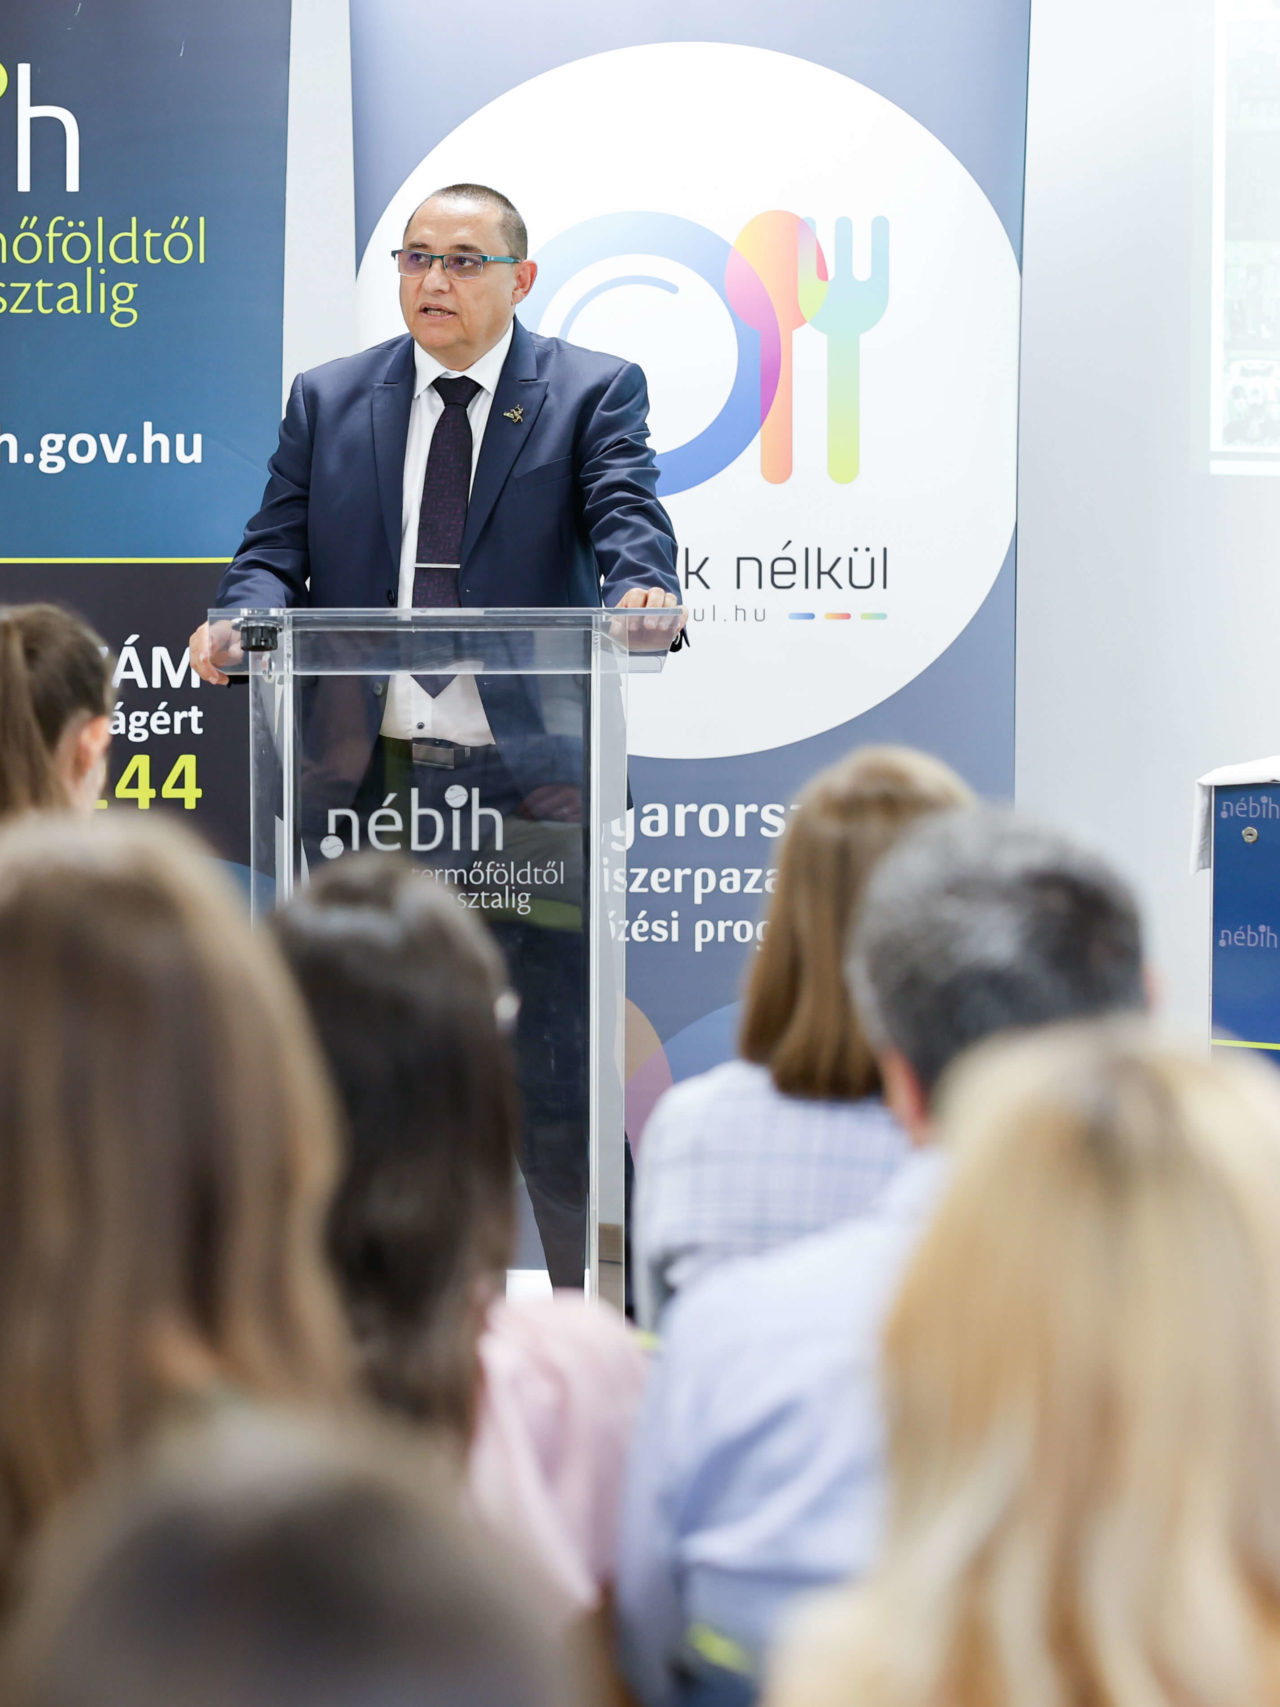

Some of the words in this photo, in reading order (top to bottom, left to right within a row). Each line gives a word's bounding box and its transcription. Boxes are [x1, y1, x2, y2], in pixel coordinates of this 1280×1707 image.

[684, 547, 711, 590] k
[736, 540, 888, 590] nélkül
[693, 604, 766, 623] ul.hu
[108, 701, 204, 743] ágért
[94, 754, 203, 810] 44
[320, 784, 504, 859] nébih
[1220, 796, 1280, 819] nébih
[448, 886, 532, 915] sztalig
[602, 857, 780, 905] iszerpaza
[1219, 924, 1278, 949] nébih
